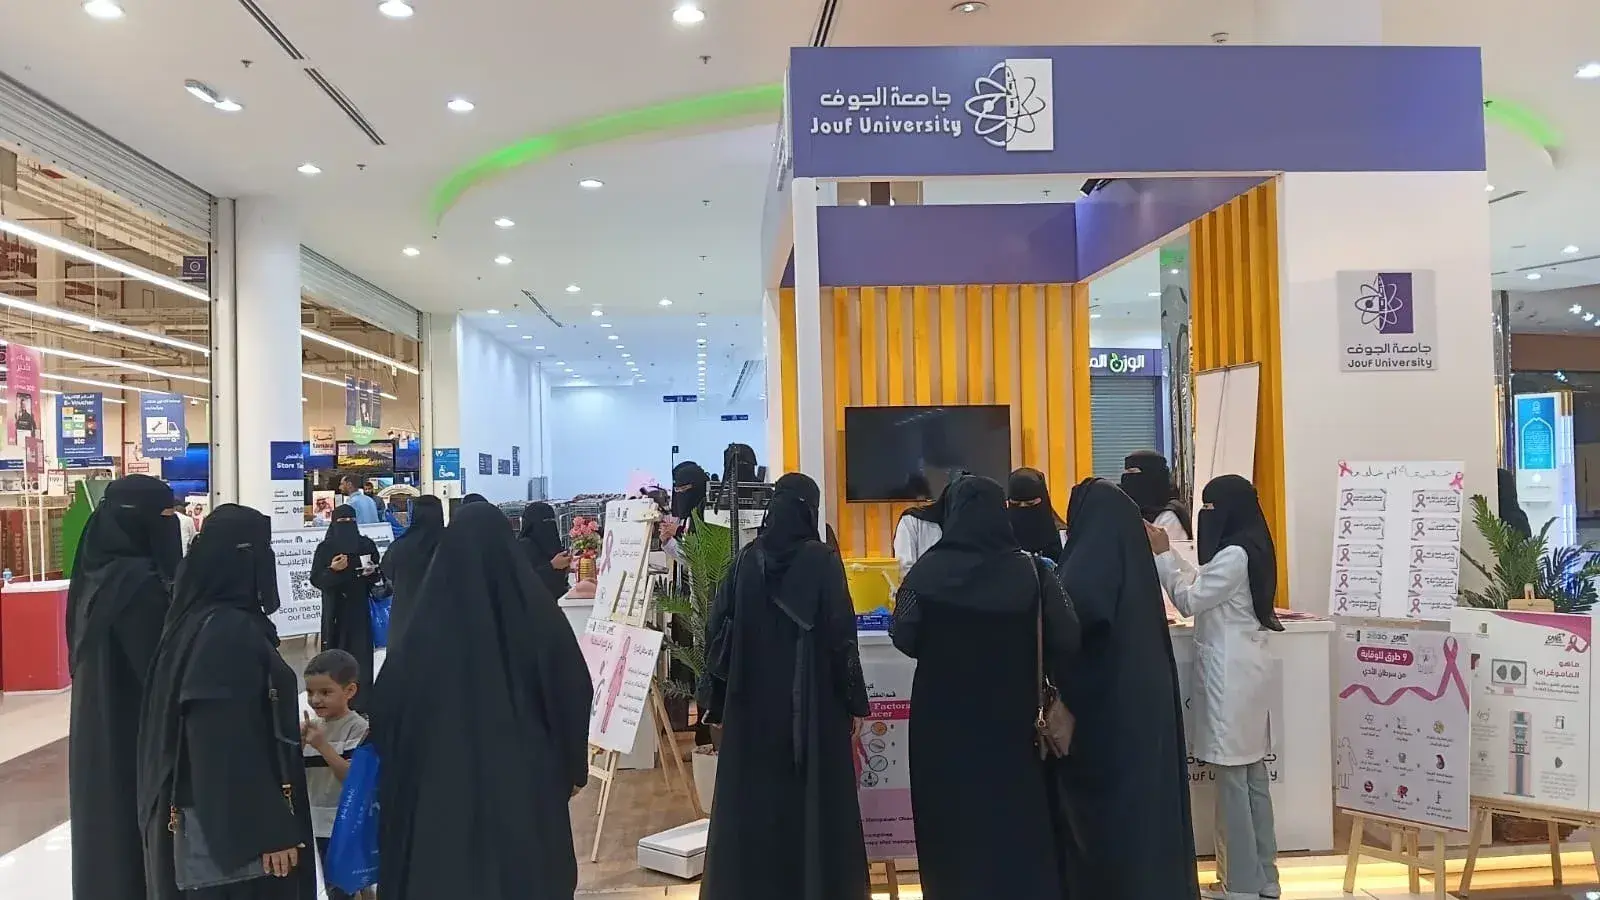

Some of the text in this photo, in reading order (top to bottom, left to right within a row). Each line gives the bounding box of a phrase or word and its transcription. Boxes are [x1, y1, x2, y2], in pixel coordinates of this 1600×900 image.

[820, 85, 952, 112] جامعة الجوف
[810, 116, 962, 137] Jouf University
[1347, 342, 1432, 355] جامعة الجوف
[1109, 352, 1145, 373] الوزن
[1347, 357, 1432, 369] Jouf University
[279, 606, 298, 614] Scan
[1360, 648, 1384, 661] للوقاية
[1384, 651, 1401, 663] طرق
[1378, 668, 1397, 678] سرطان
[1187, 771, 1206, 781] ouf
